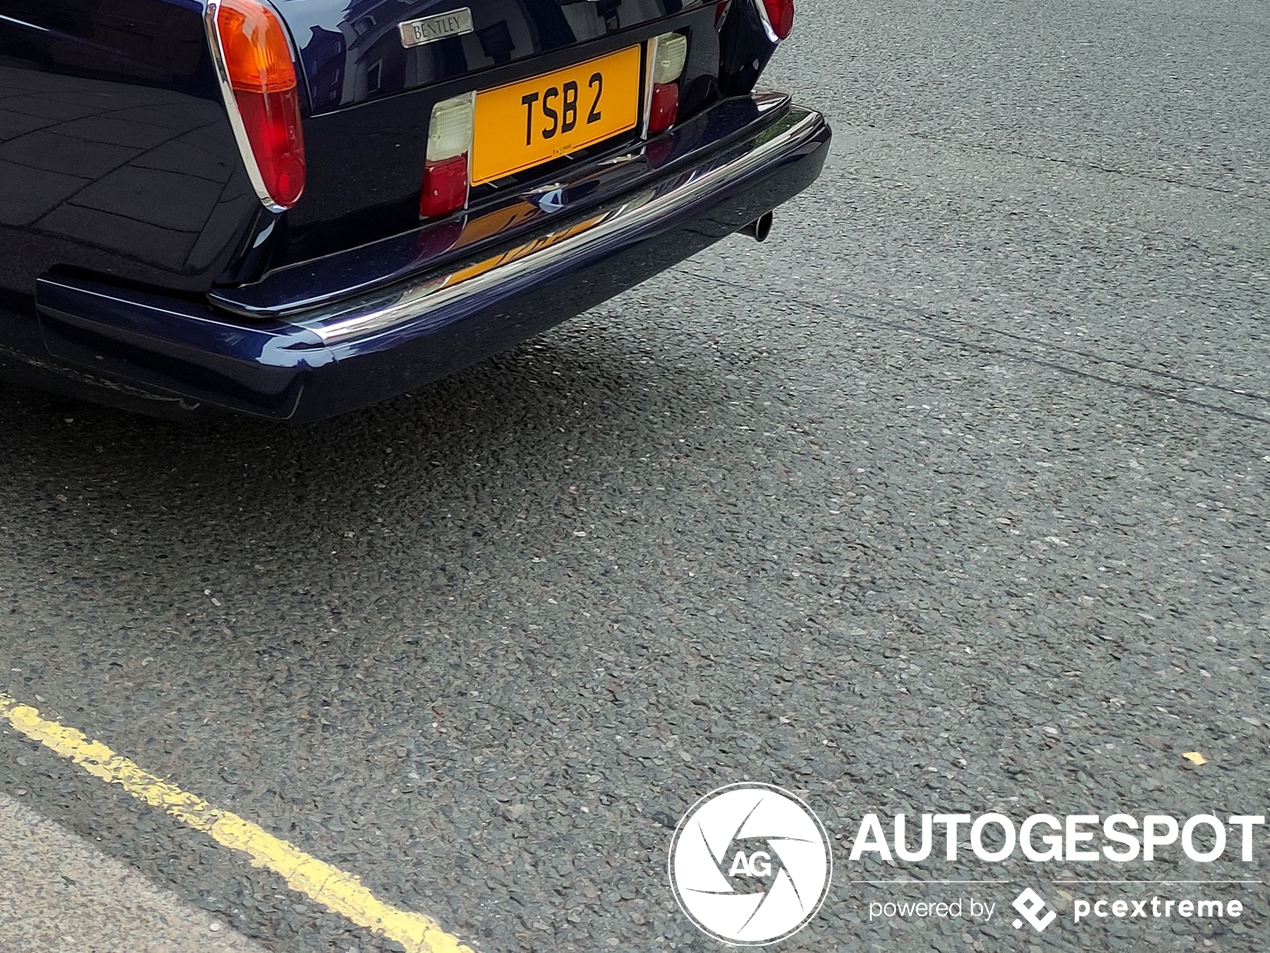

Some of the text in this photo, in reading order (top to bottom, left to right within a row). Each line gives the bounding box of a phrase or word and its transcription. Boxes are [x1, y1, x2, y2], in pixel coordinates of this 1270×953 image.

[412, 15, 461, 40] BENTLEY
[521, 71, 603, 147] TSB 2
